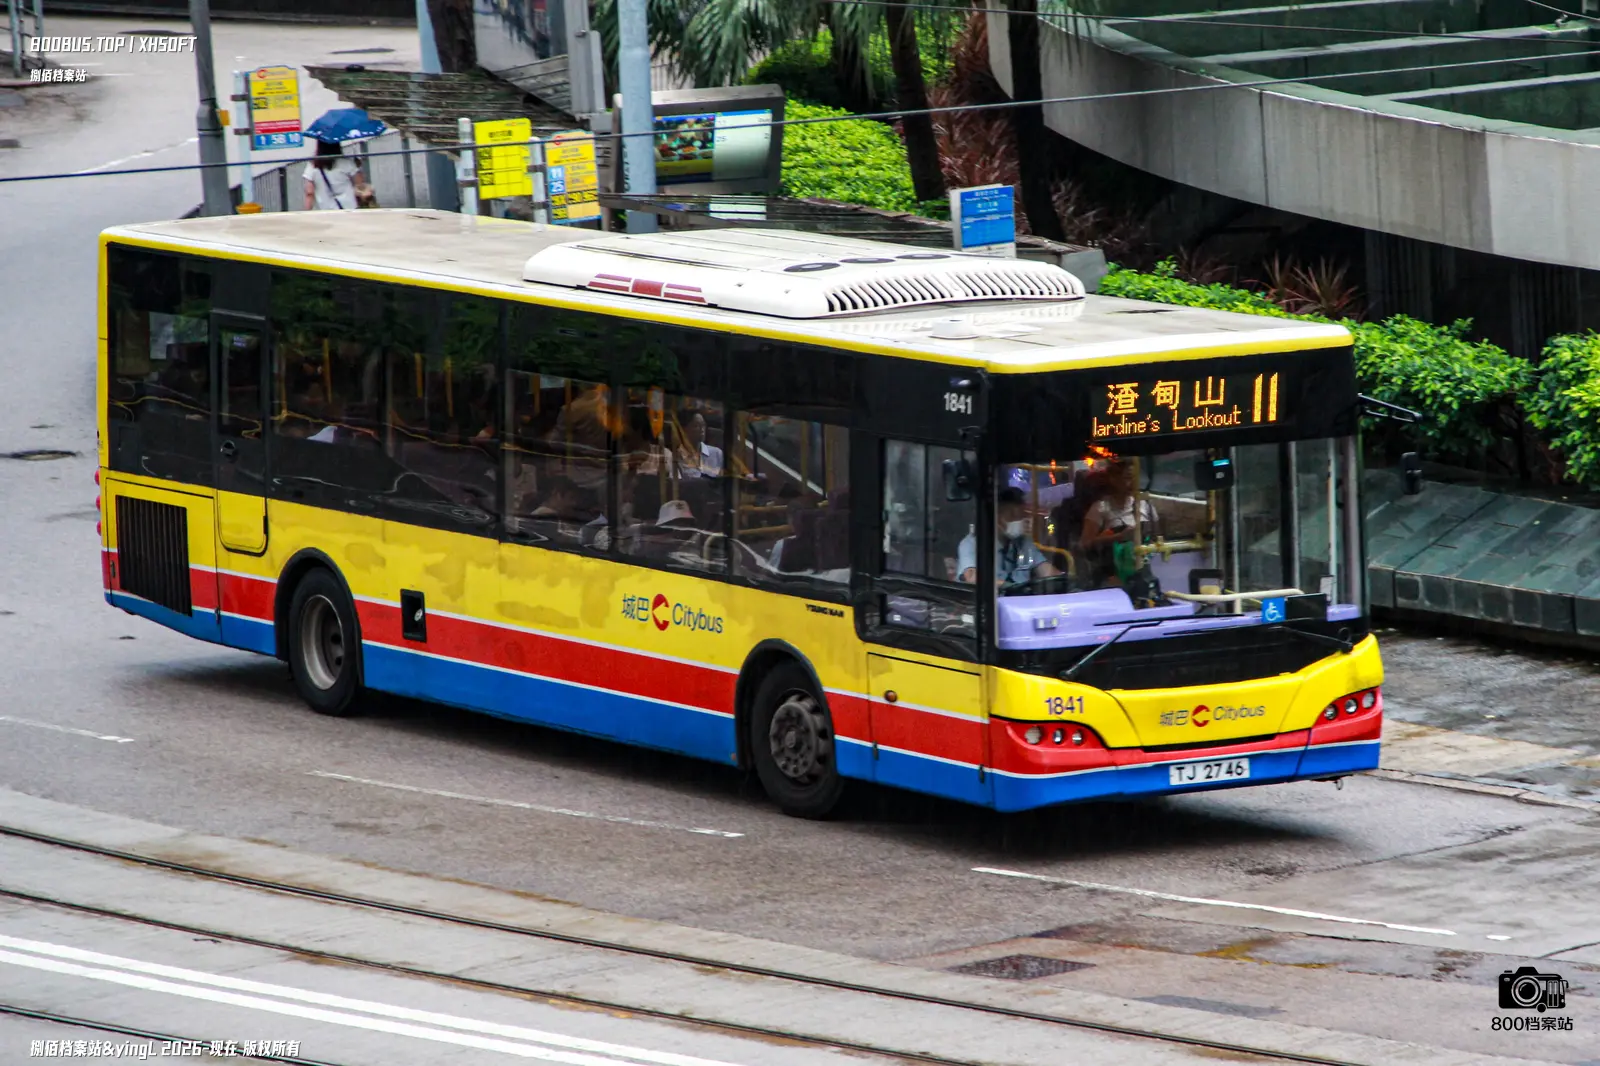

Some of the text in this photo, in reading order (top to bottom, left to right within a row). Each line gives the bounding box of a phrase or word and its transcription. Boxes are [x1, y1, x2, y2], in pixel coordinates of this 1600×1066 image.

[943, 392, 973, 415] 1841
[1107, 376, 1226, 415] 渣甸山
[1253, 372, 1279, 423] 11
[1172, 404, 1242, 430] Lookout
[621, 593, 650, 622] 城巴
[672, 602, 724, 634] Citybus
[1045, 696, 1084, 715] 1841
[1159, 709, 1190, 726] 城巴
[1213, 704, 1266, 721] Citybus
[1175, 761, 1245, 781] TJ 2746
